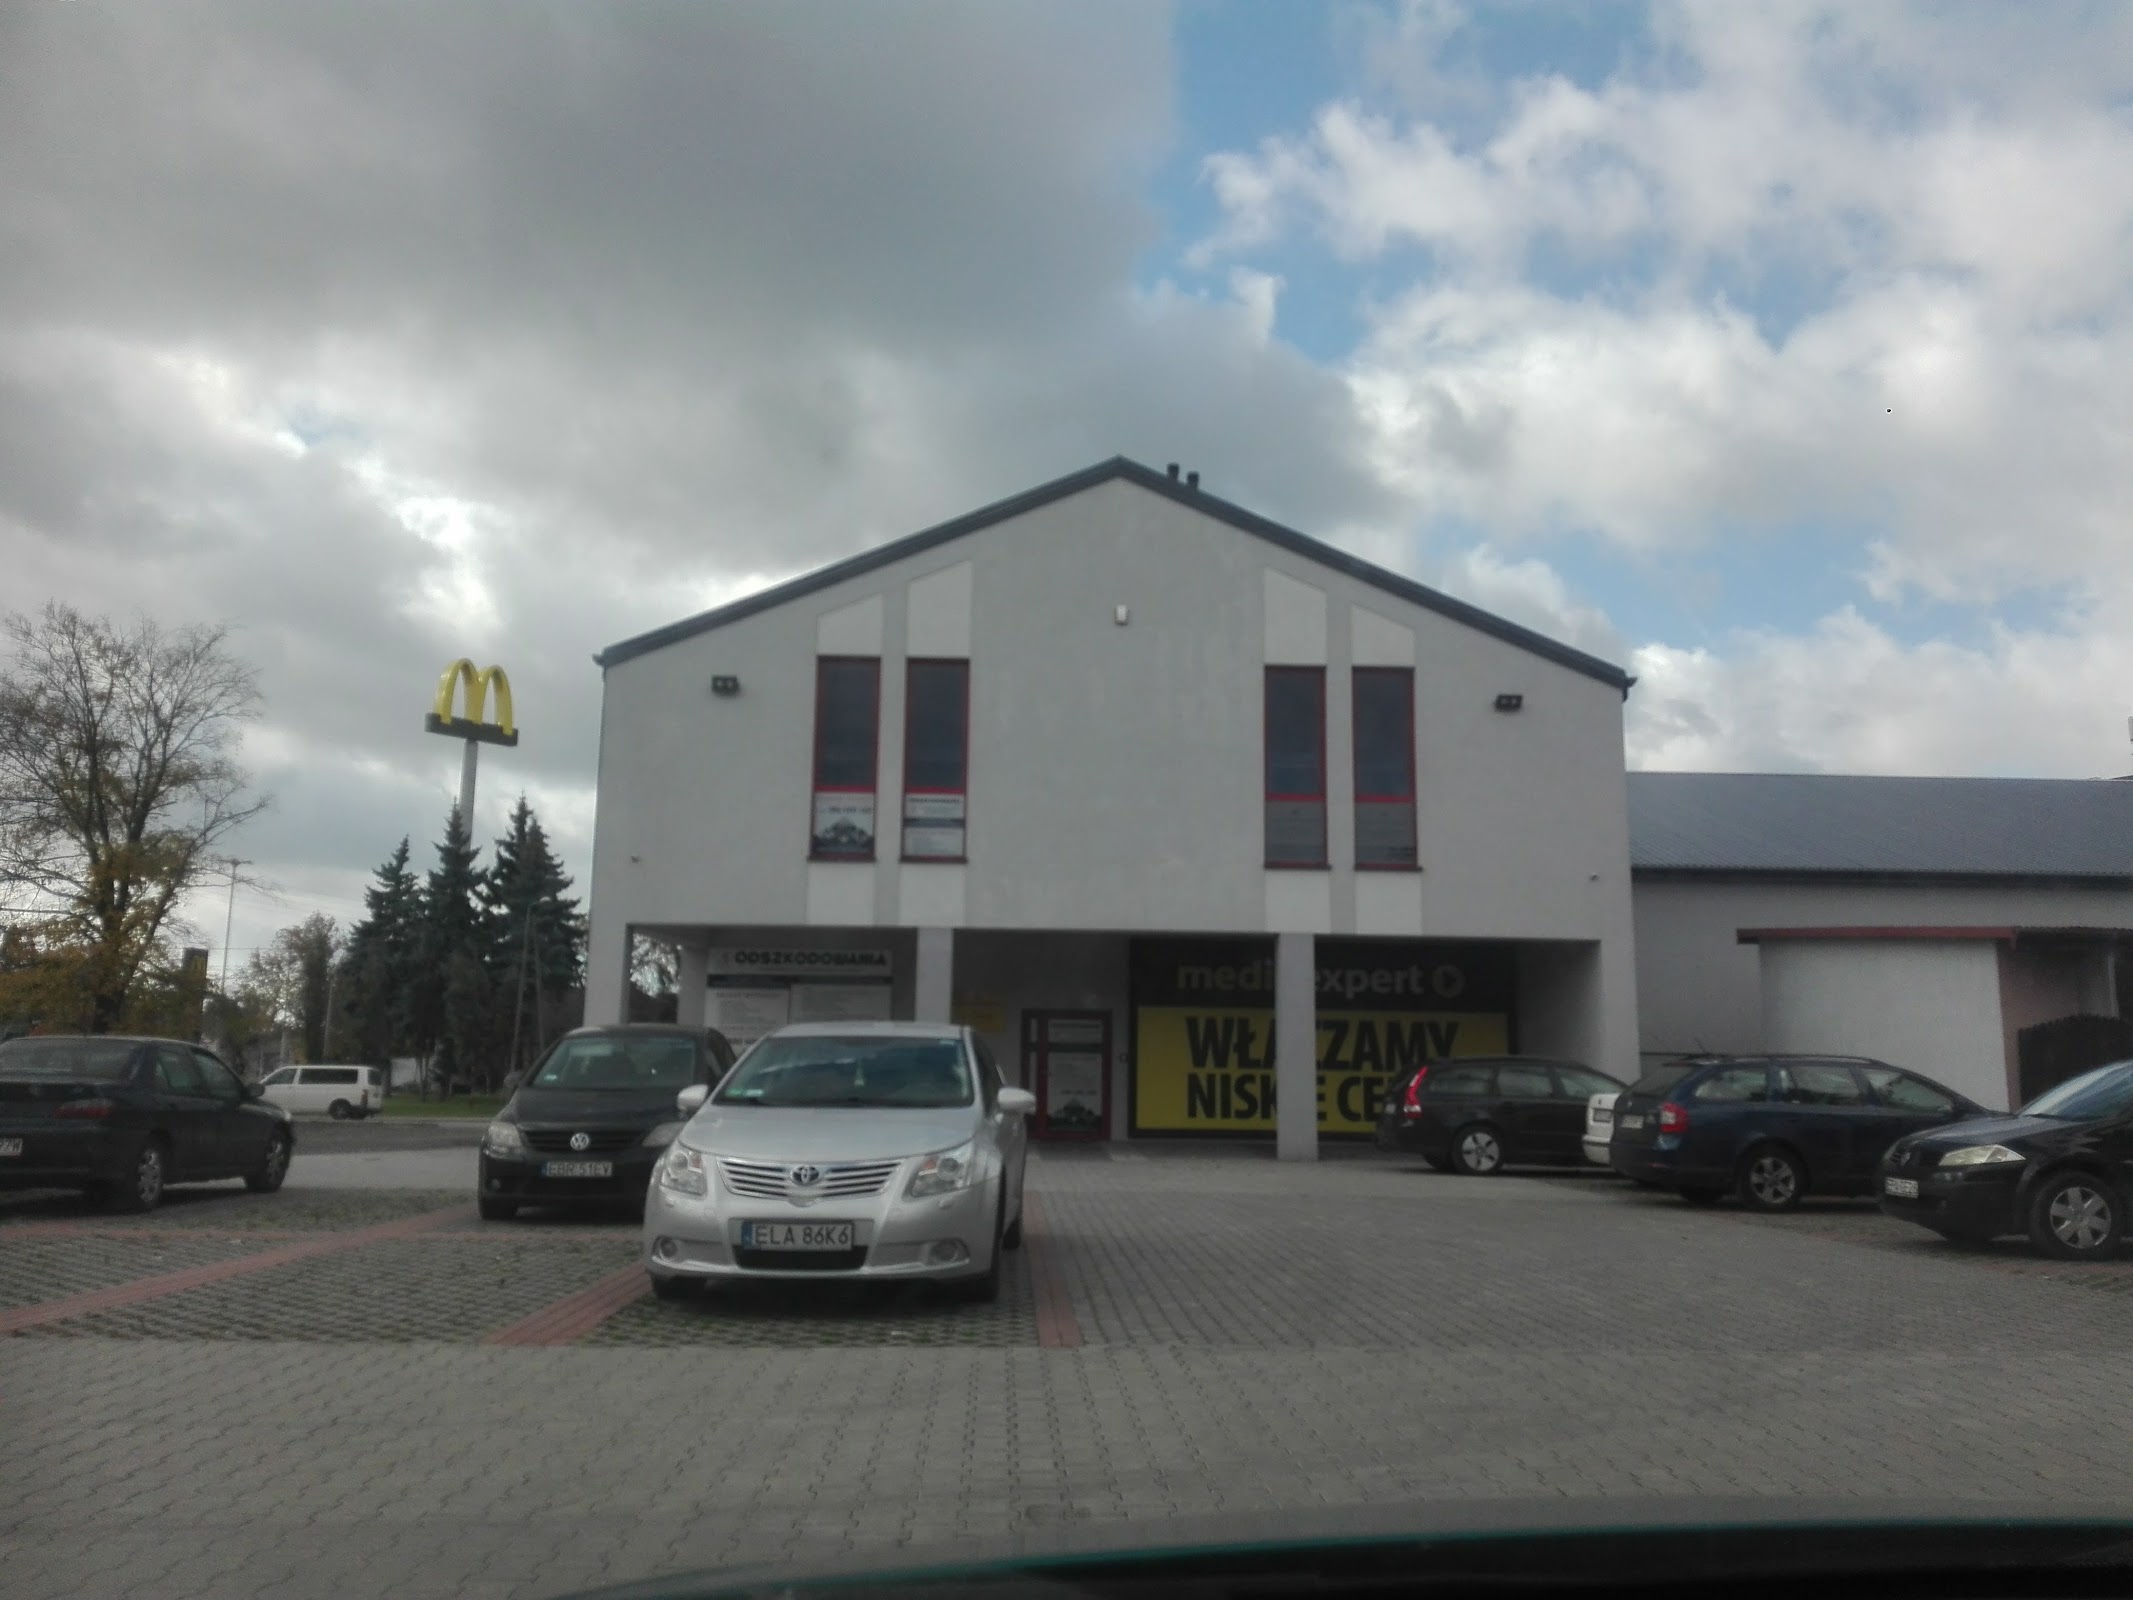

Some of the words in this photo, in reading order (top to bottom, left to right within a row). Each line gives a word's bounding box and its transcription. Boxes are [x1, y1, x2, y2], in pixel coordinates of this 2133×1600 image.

[735, 951, 887, 966] ODSZKODOWANIA
[1177, 958, 1275, 990] medi
[1315, 963, 1425, 999] xpert
[1185, 1017, 1459, 1070] WŁZAMY
[1188, 1074, 1326, 1121] NISKE
[1337, 1076, 1393, 1122] CE
[756, 1224, 795, 1245] ELA
[802, 1225, 849, 1245] 86K6
